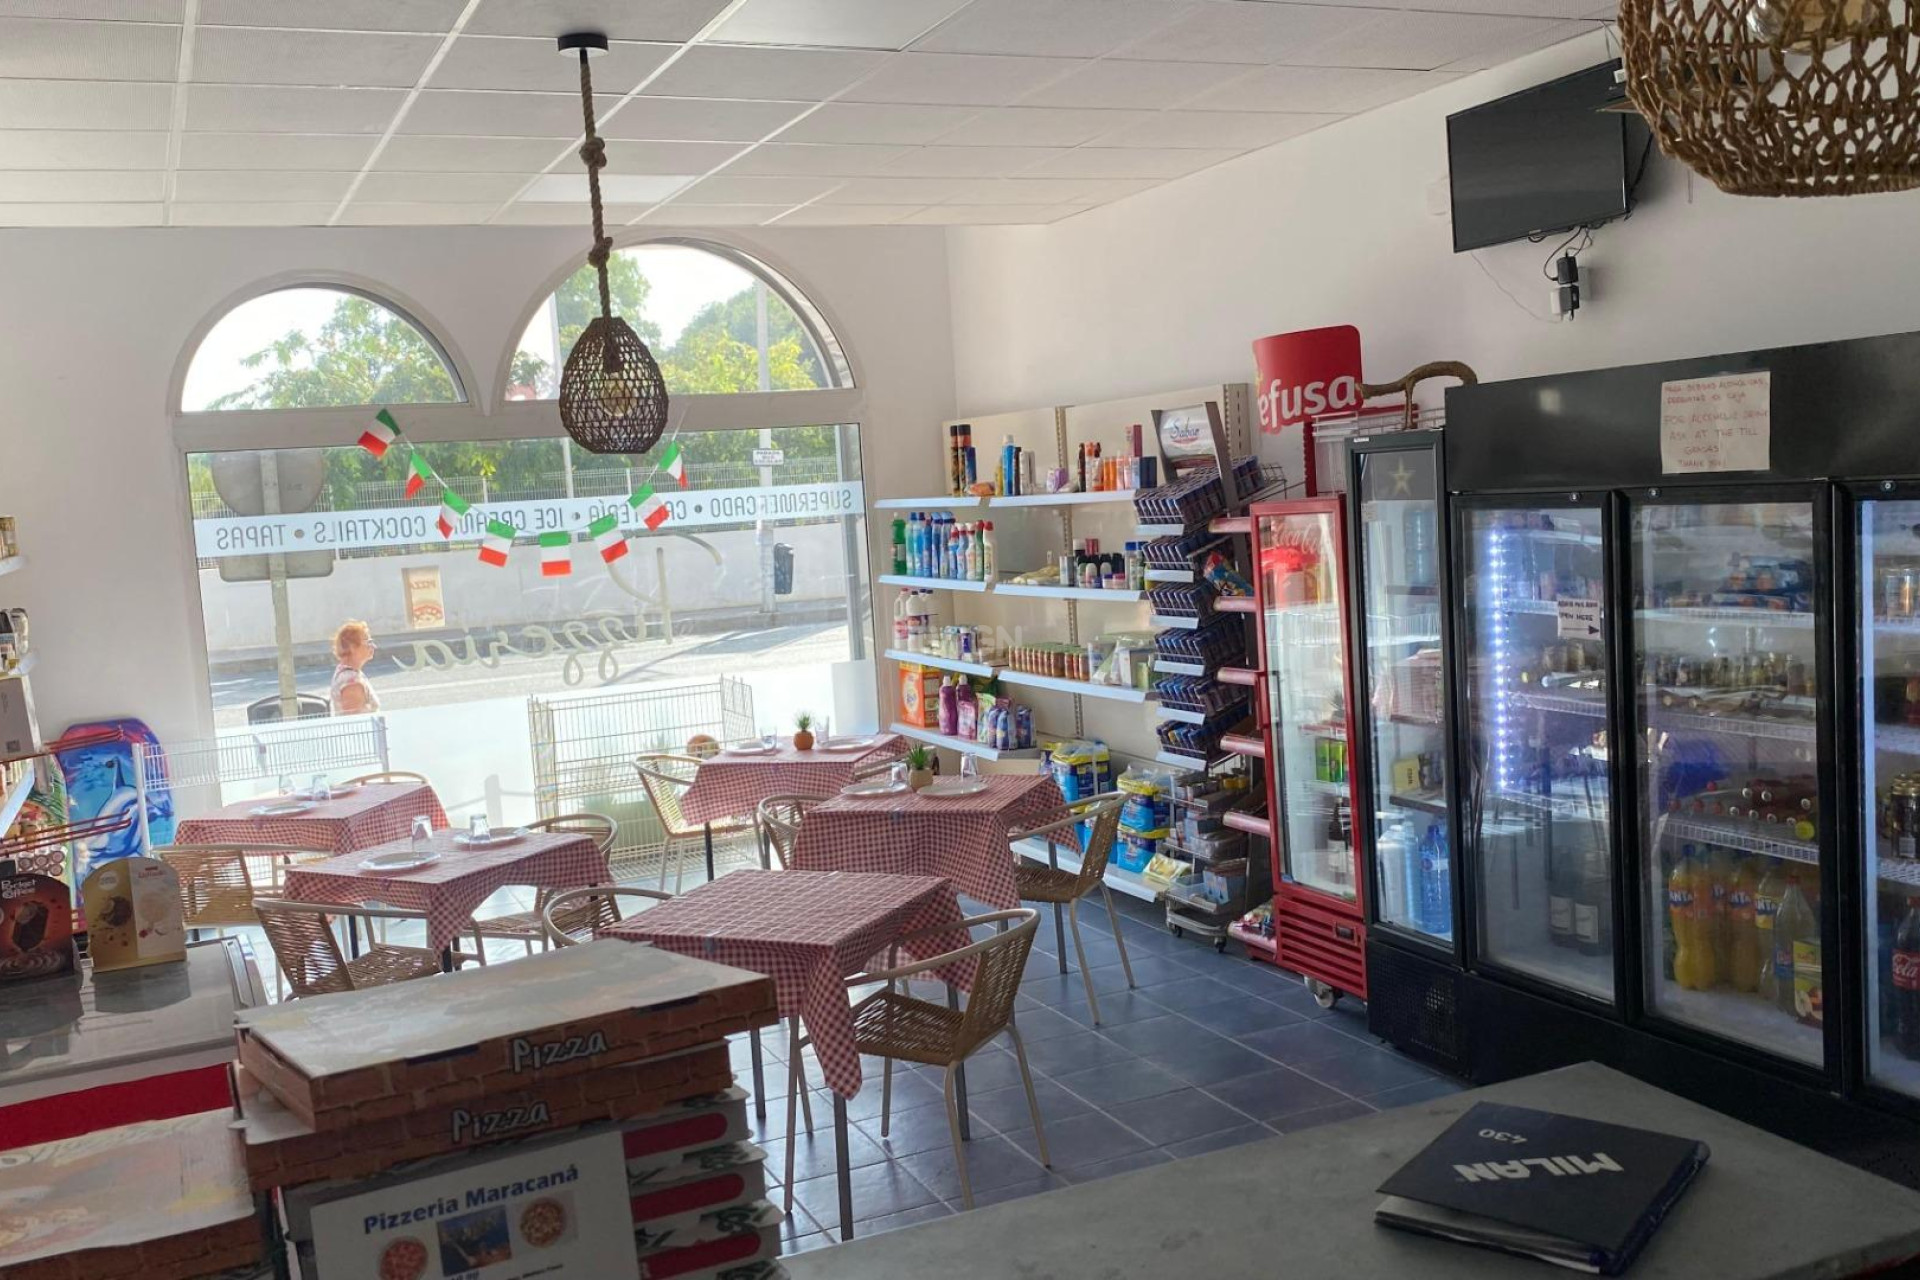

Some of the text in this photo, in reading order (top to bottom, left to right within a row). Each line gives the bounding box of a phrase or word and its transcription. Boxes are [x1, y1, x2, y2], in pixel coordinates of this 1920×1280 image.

[1258, 375, 1357, 428] efusa
[511, 1030, 608, 1074] Pizza
[452, 1102, 550, 1143] Pizza
[1478, 1128, 1528, 1144] 430
[1452, 1152, 1625, 1183] MILAN
[363, 1163, 580, 1235] Pizzeria Maracaná
